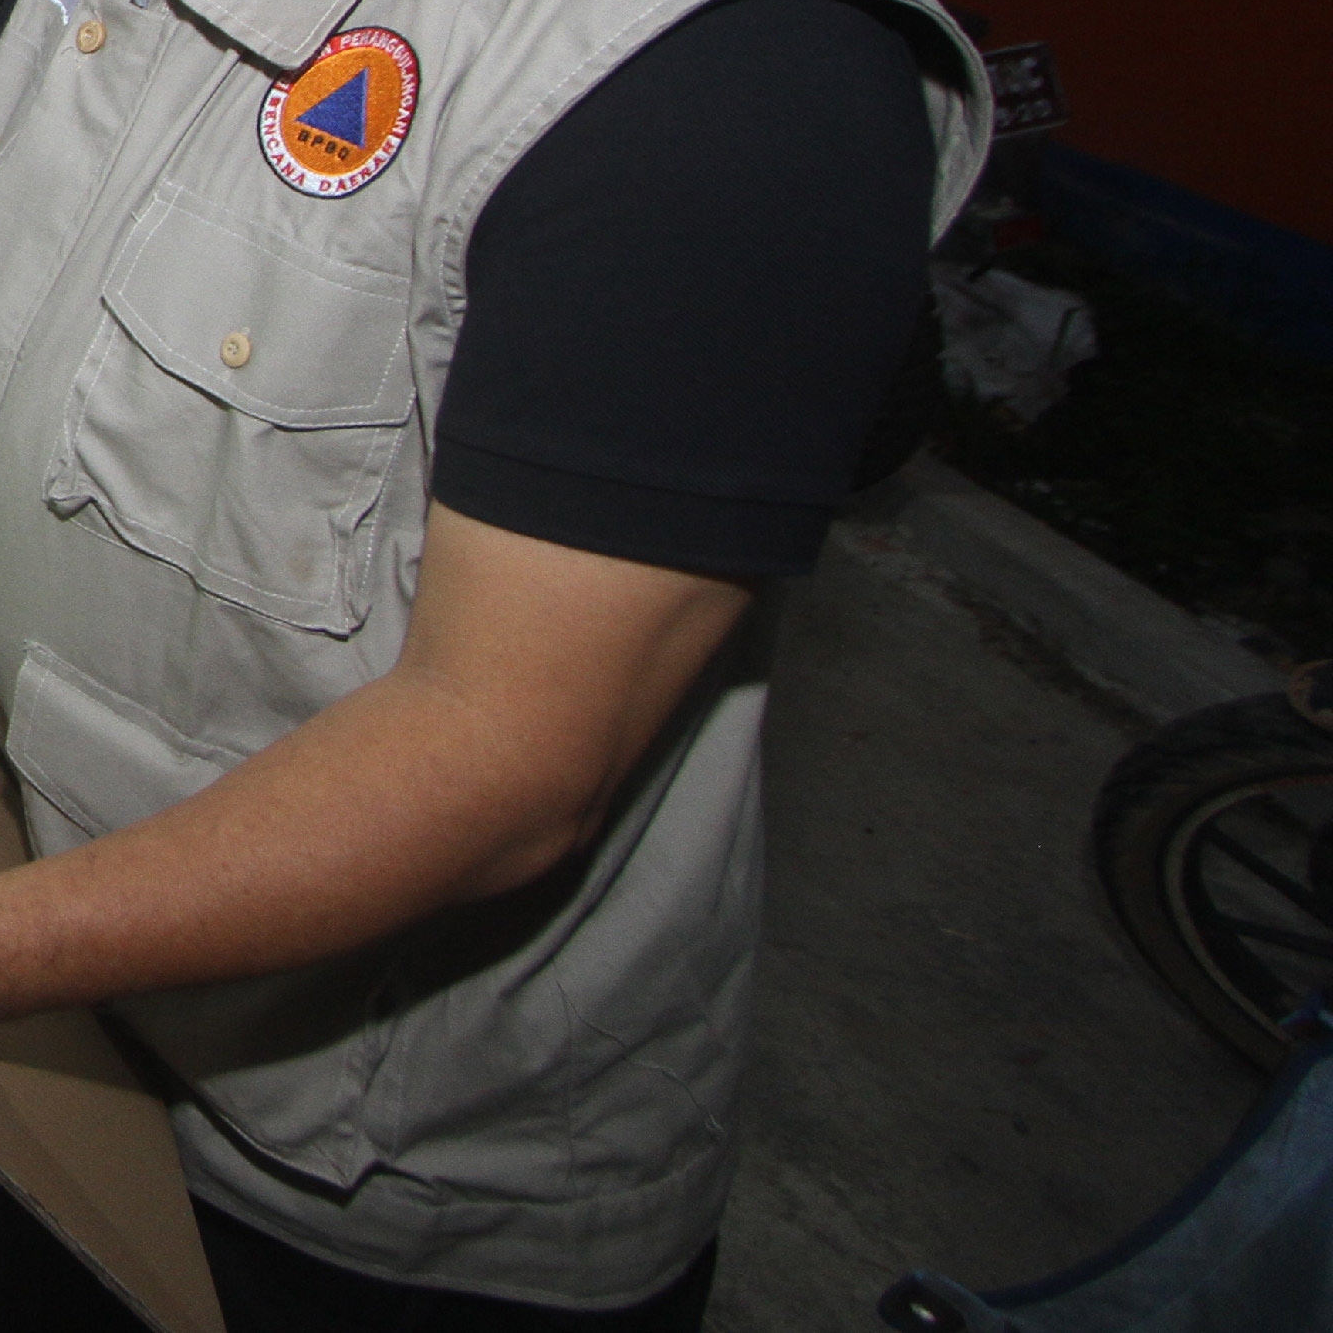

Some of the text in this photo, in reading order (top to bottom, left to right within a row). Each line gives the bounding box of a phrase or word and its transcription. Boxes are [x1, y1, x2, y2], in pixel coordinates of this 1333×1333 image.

[340, 30, 416, 134] PENANGGULANGAN
[263, 96, 397, 192] BENCANA DAERAH
